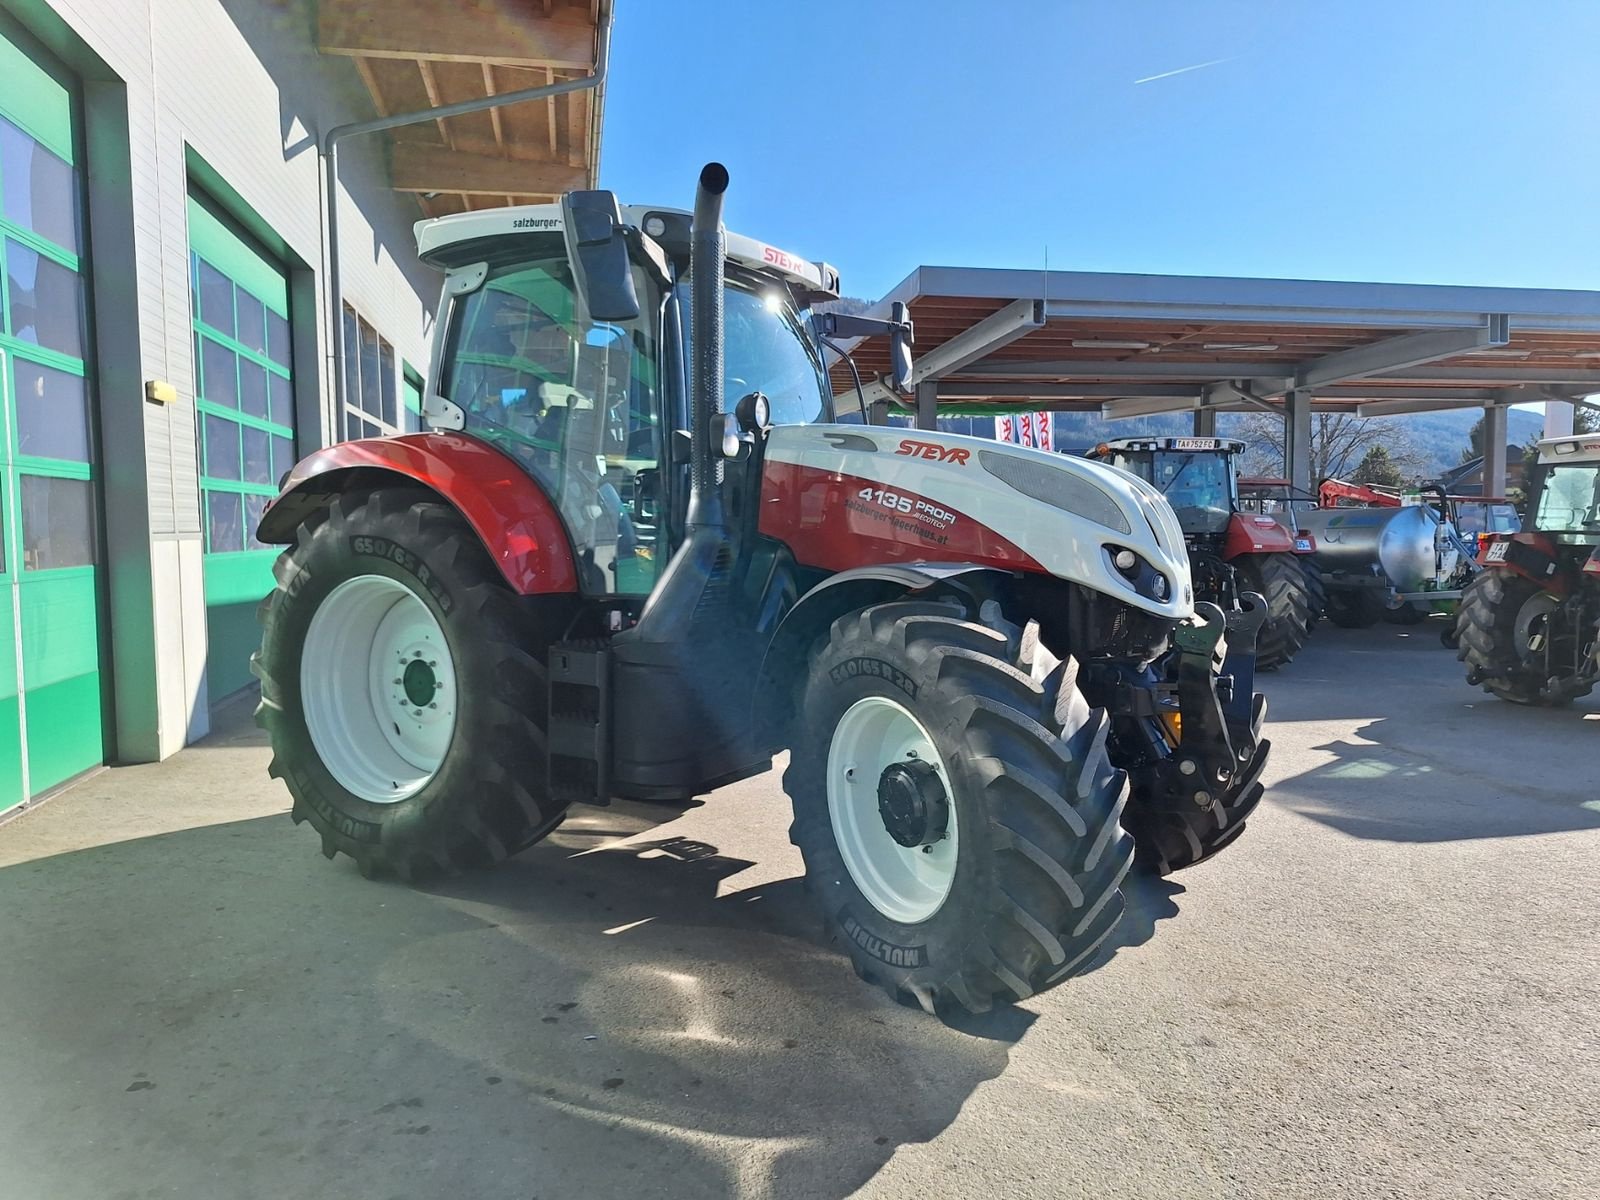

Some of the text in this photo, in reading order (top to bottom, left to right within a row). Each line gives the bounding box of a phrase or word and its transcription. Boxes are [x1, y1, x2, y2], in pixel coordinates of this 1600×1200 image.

[513, 218, 562, 229] salzburger-
[764, 247, 802, 273] STEYR
[895, 440, 970, 466] STEYR
[858, 487, 957, 525] 4135 PROFI
[418, 563, 430, 585] R
[882, 663, 893, 680] R
